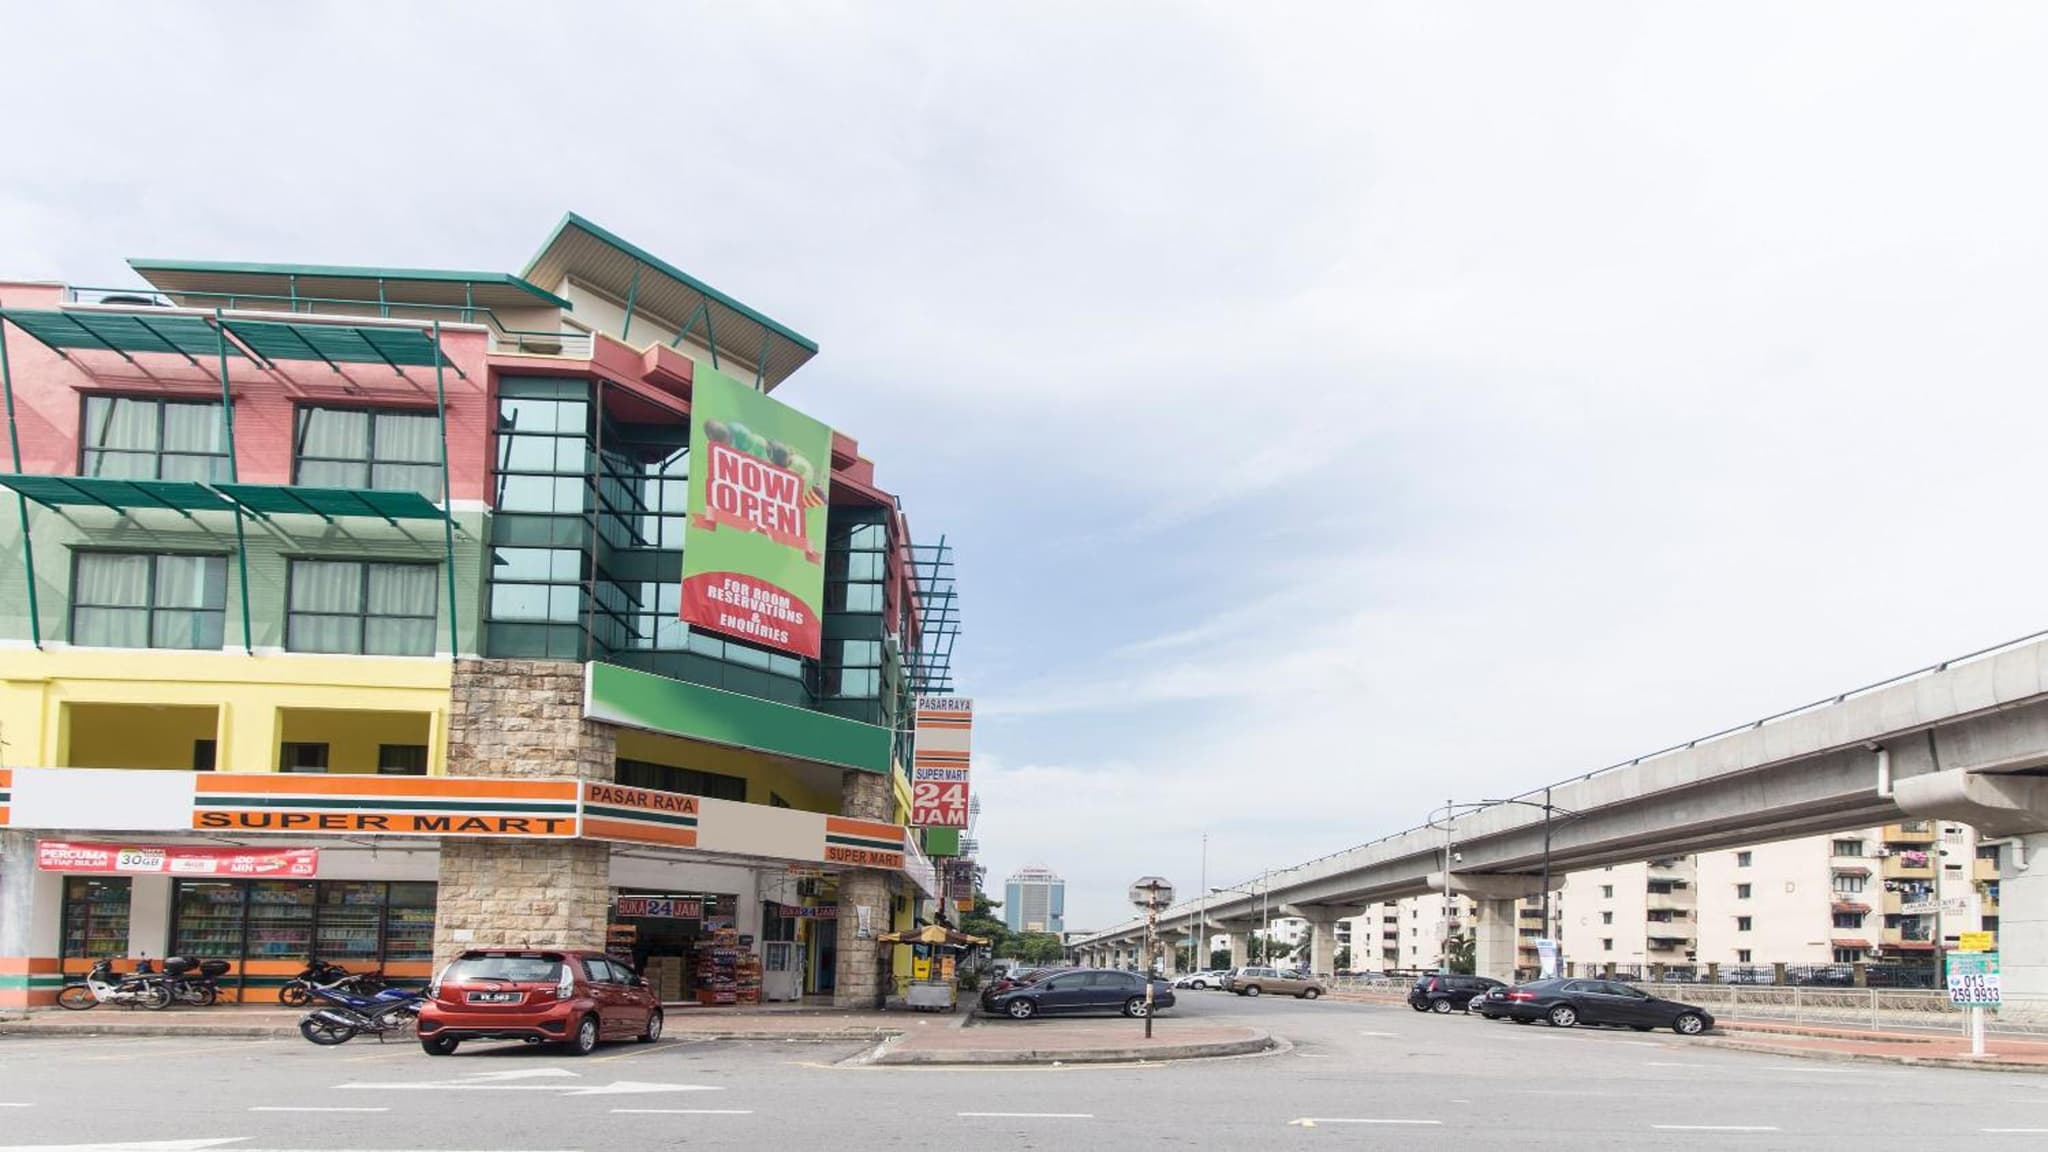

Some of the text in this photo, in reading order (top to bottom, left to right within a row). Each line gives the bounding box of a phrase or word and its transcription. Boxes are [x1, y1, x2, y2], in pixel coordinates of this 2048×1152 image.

[718, 451, 797, 504] NOW
[716, 482, 797, 536] OPEN
[724, 579, 791, 609] FOR ROOM
[707, 585, 804, 625] RESERVATIONS
[751, 612, 761, 623] &
[720, 613, 789, 643] ENQUIRIES
[920, 698, 970, 711] PASAR RAYA
[917, 768, 968, 781] SUPER MART
[591, 786, 694, 813] PASAR RAYA
[915, 783, 966, 809] 24
[200, 811, 566, 833] SUPER MART
[914, 809, 965, 825] JAM
[41, 849, 107, 861] PERCUMA
[829, 847, 899, 865] SUPER MART
[620, 900, 699, 917] BUKA 24 JAM
[1964, 975, 1985, 988] 013
[1951, 987, 2000, 1002] 259 9933
